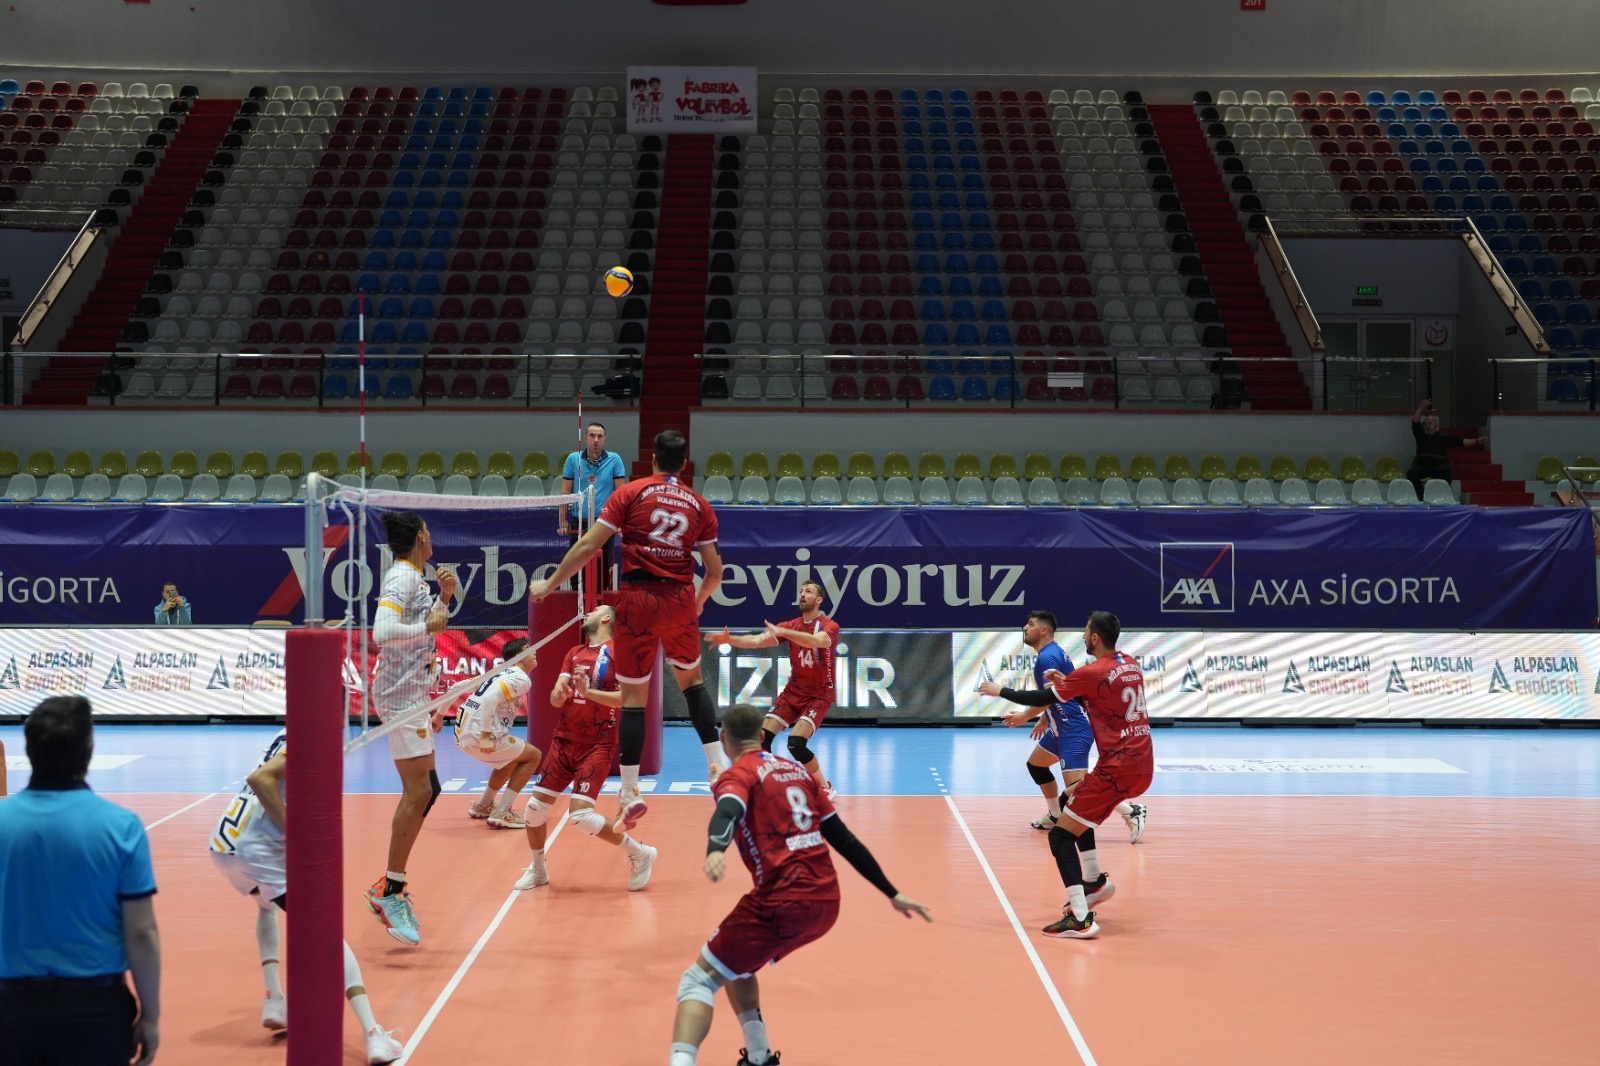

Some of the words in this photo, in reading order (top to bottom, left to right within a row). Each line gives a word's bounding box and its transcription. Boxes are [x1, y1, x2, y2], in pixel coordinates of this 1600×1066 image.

[675, 97, 751, 115] VOLEYBOL
[656, 495, 690, 509] VOLEYBOL
[648, 508, 688, 546] 22
[1162, 577, 1221, 605] AXA
[1248, 578, 1311, 606] AXA
[28, 651, 94, 668] ALPASLAN
[133, 652, 198, 668] ALPASLAN
[797, 649, 814, 669] 14
[1205, 655, 1268, 672] ALPASLAN
[1307, 655, 1371, 672] ALPASLAN
[1410, 656, 1474, 673] ALPASLAN
[1513, 656, 1579, 673] ALPASLAN
[717, 643, 898, 709] İZİR
[1121, 683, 1148, 722] 24
[808, 709, 818, 719] 14
[579, 781, 590, 793] 10
[785, 785, 814, 832] 8
